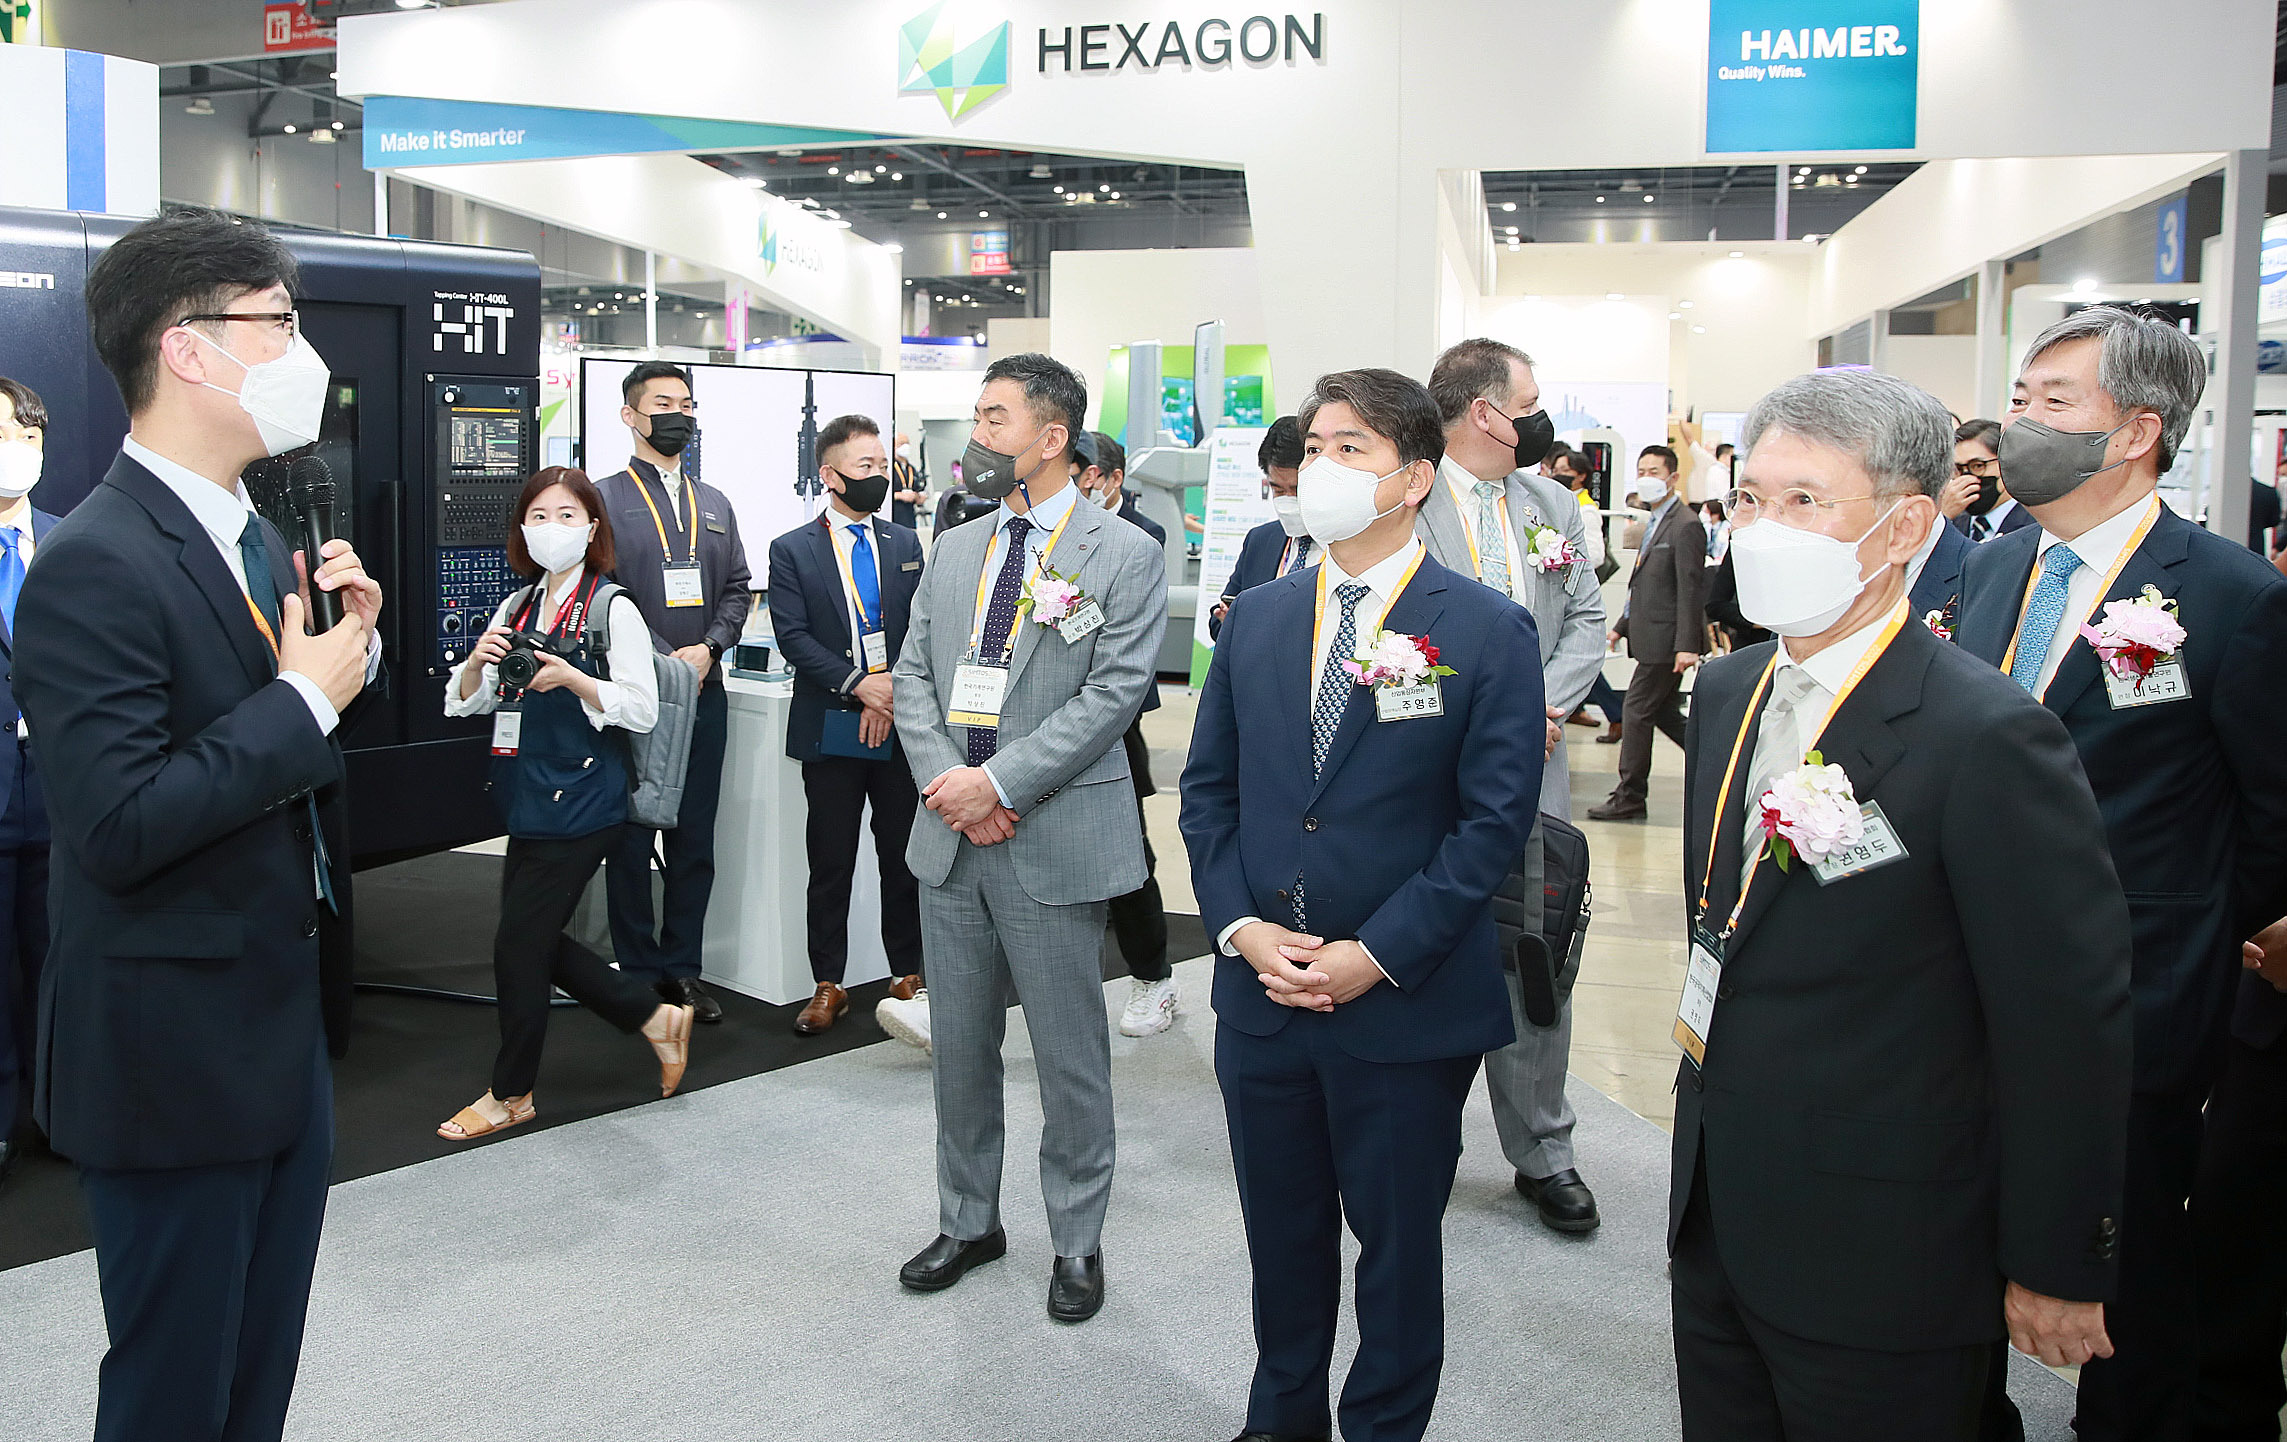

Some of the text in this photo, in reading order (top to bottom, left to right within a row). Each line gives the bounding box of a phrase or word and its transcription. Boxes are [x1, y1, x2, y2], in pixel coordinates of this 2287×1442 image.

[1039, 13, 1322, 72] HEXAGON
[1718, 64, 1806, 82] Quality Wins.
[381, 127, 526, 152] Make it Smarter
[2160, 210, 2178, 275] 3
[469, 292, 509, 305] HIT-400L
[433, 302, 515, 355] HIT
[567, 601, 584, 632] Canon
[1402, 697, 1438, 711] 주영준
